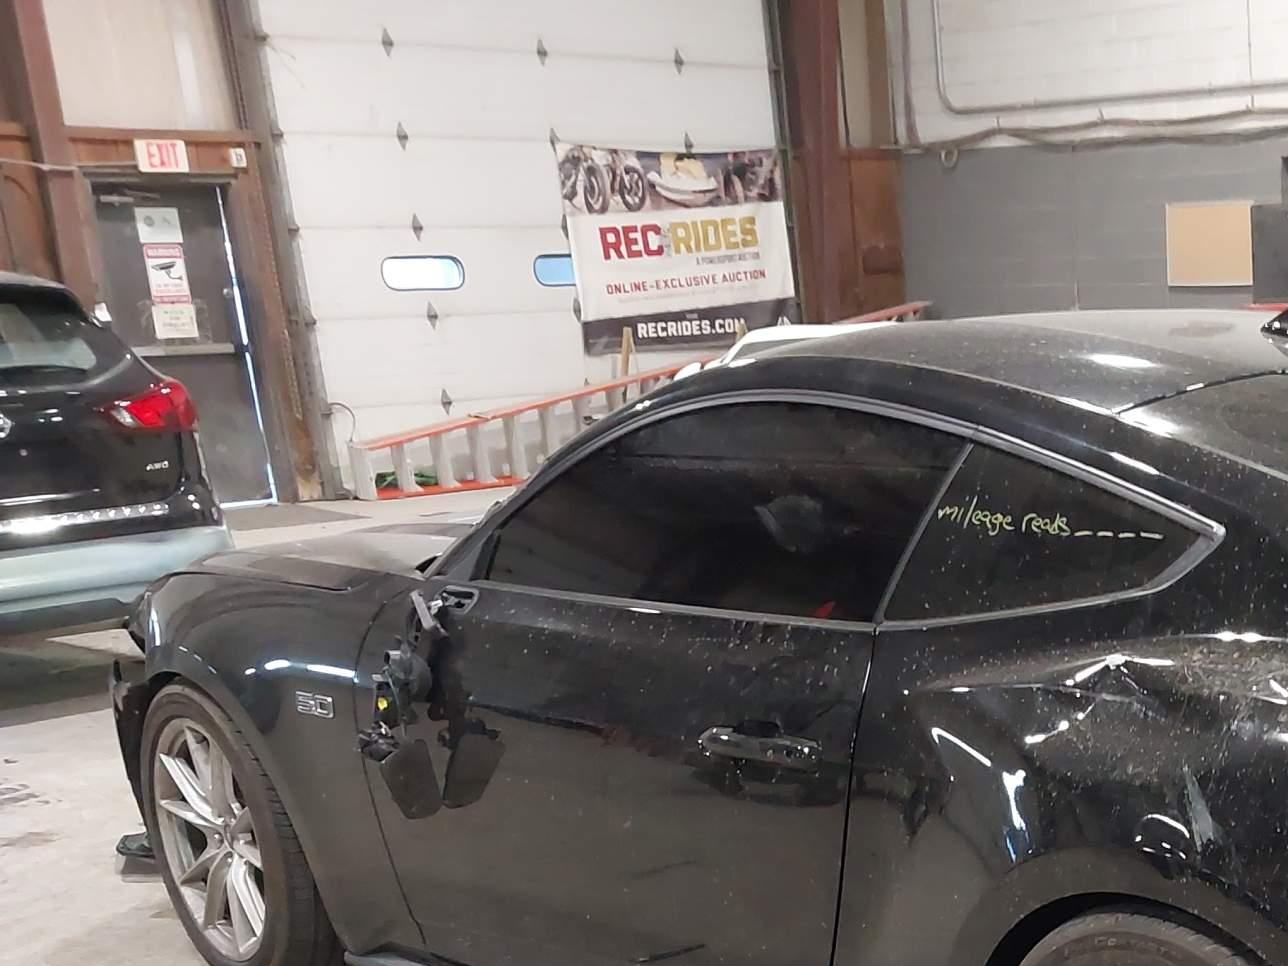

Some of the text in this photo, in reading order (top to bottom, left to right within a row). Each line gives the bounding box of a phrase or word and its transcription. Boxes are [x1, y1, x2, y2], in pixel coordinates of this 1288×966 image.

[144, 142, 180, 168] EXIT
[606, 273, 718, 295] ONLINE-EXCLUSIVE
[722, 269, 767, 283] AUCTION
[937, 495, 1016, 536] mileage
